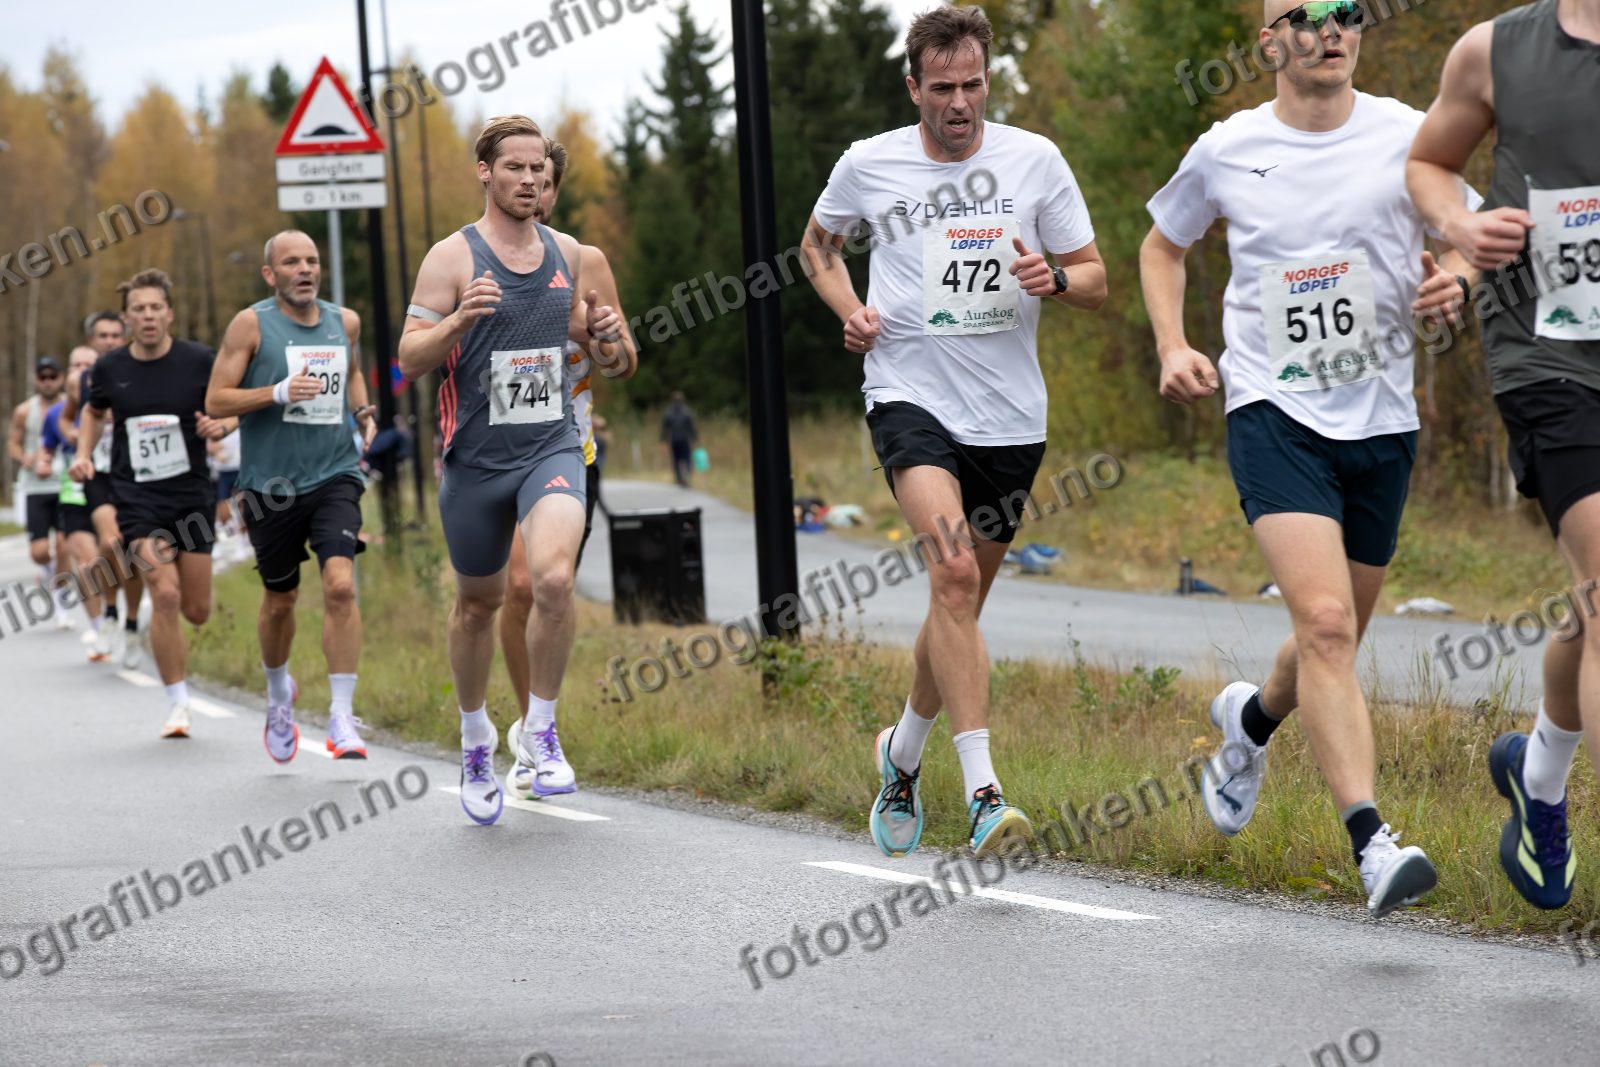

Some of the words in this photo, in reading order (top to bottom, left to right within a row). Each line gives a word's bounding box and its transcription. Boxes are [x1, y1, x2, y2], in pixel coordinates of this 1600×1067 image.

[1556, 198, 1600, 214] NOR
[946, 228, 1004, 240] NORGES
[950, 239, 995, 250] LØPET
[1559, 238, 1600, 285] 59
[942, 258, 1001, 293] 472
[1283, 262, 1350, 283] NORGES
[1289, 276, 1341, 295] LØPET
[963, 307, 1015, 321] Aurskog
[1286, 297, 1355, 344] 516
[510, 354, 553, 367] NORGES
[514, 364, 546, 375] LØPET
[308, 372, 341, 395] 08
[507, 381, 550, 409] 744
[139, 433, 171, 459] 517
